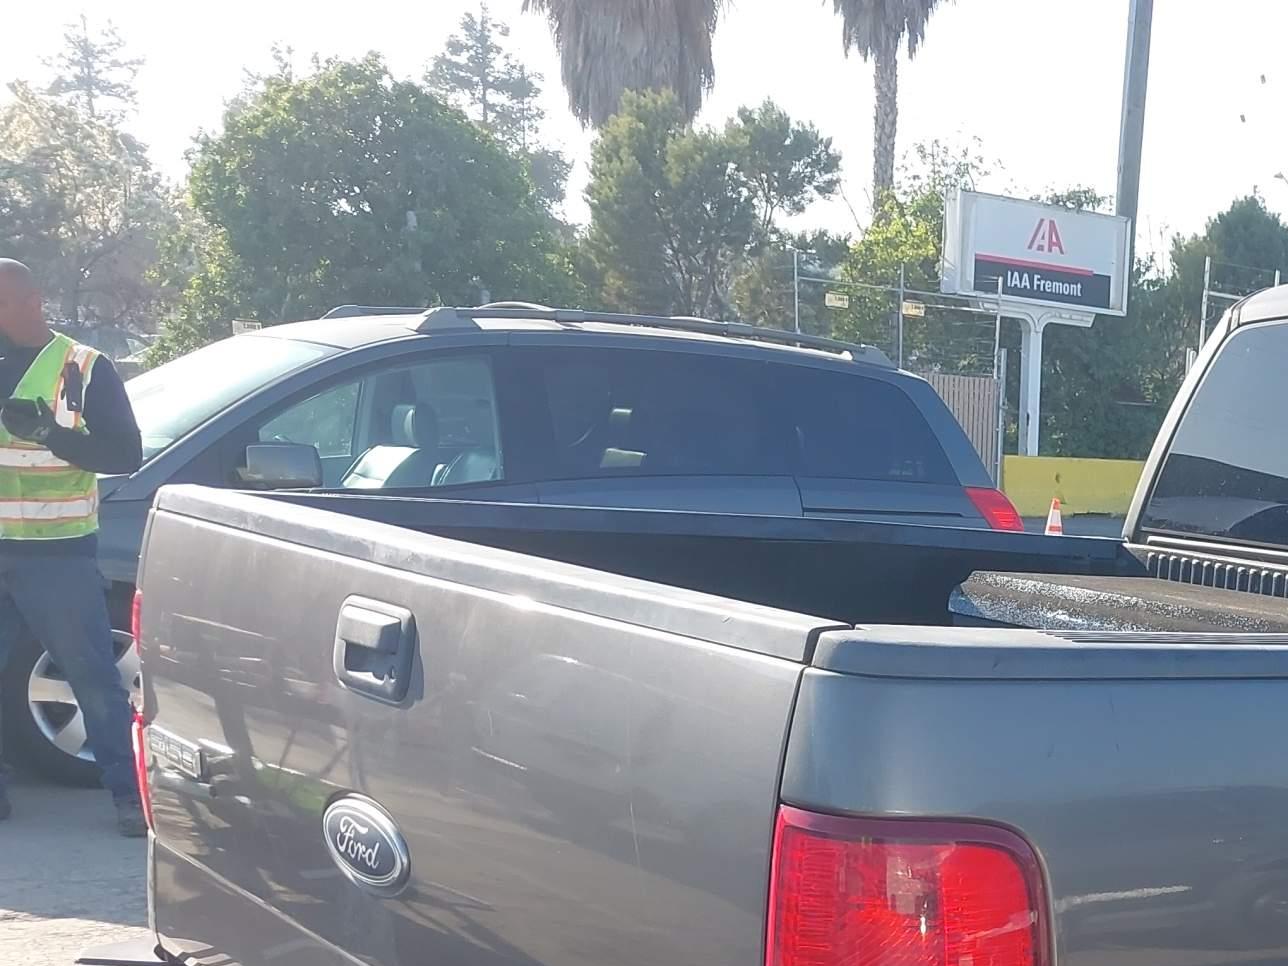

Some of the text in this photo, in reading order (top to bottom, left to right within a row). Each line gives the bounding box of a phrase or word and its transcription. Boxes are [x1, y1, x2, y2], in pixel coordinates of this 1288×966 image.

[1007, 270, 1082, 297] IAA Fremont
[336, 815, 380, 869] Ford
